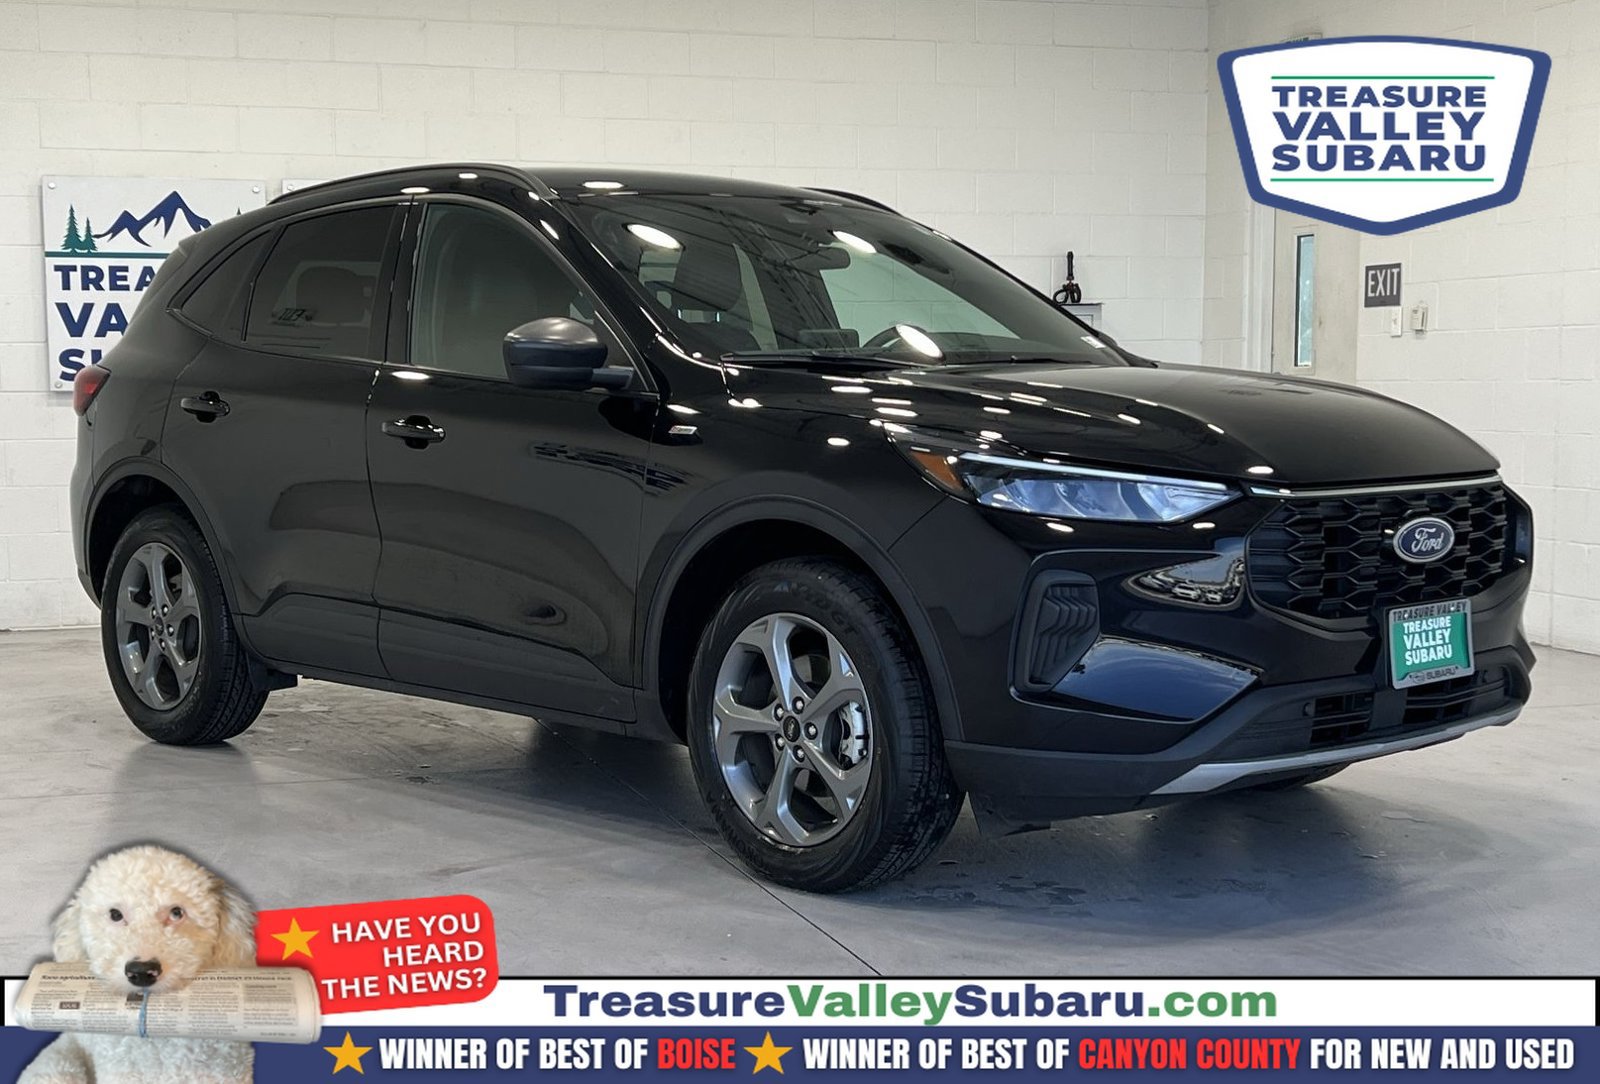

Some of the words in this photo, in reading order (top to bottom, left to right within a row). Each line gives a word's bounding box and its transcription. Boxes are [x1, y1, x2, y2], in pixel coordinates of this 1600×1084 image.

[1367, 268, 1400, 297] EXIT
[55, 302, 129, 338] VA
[1411, 527, 1445, 554] Ford
[1393, 606, 1435, 622] TREASURE
[1403, 616, 1452, 634] TREASURE
[1403, 628, 1452, 650] VALLEY
[1405, 644, 1453, 666] SUBARU
[1426, 668, 1456, 680] SUBARU
